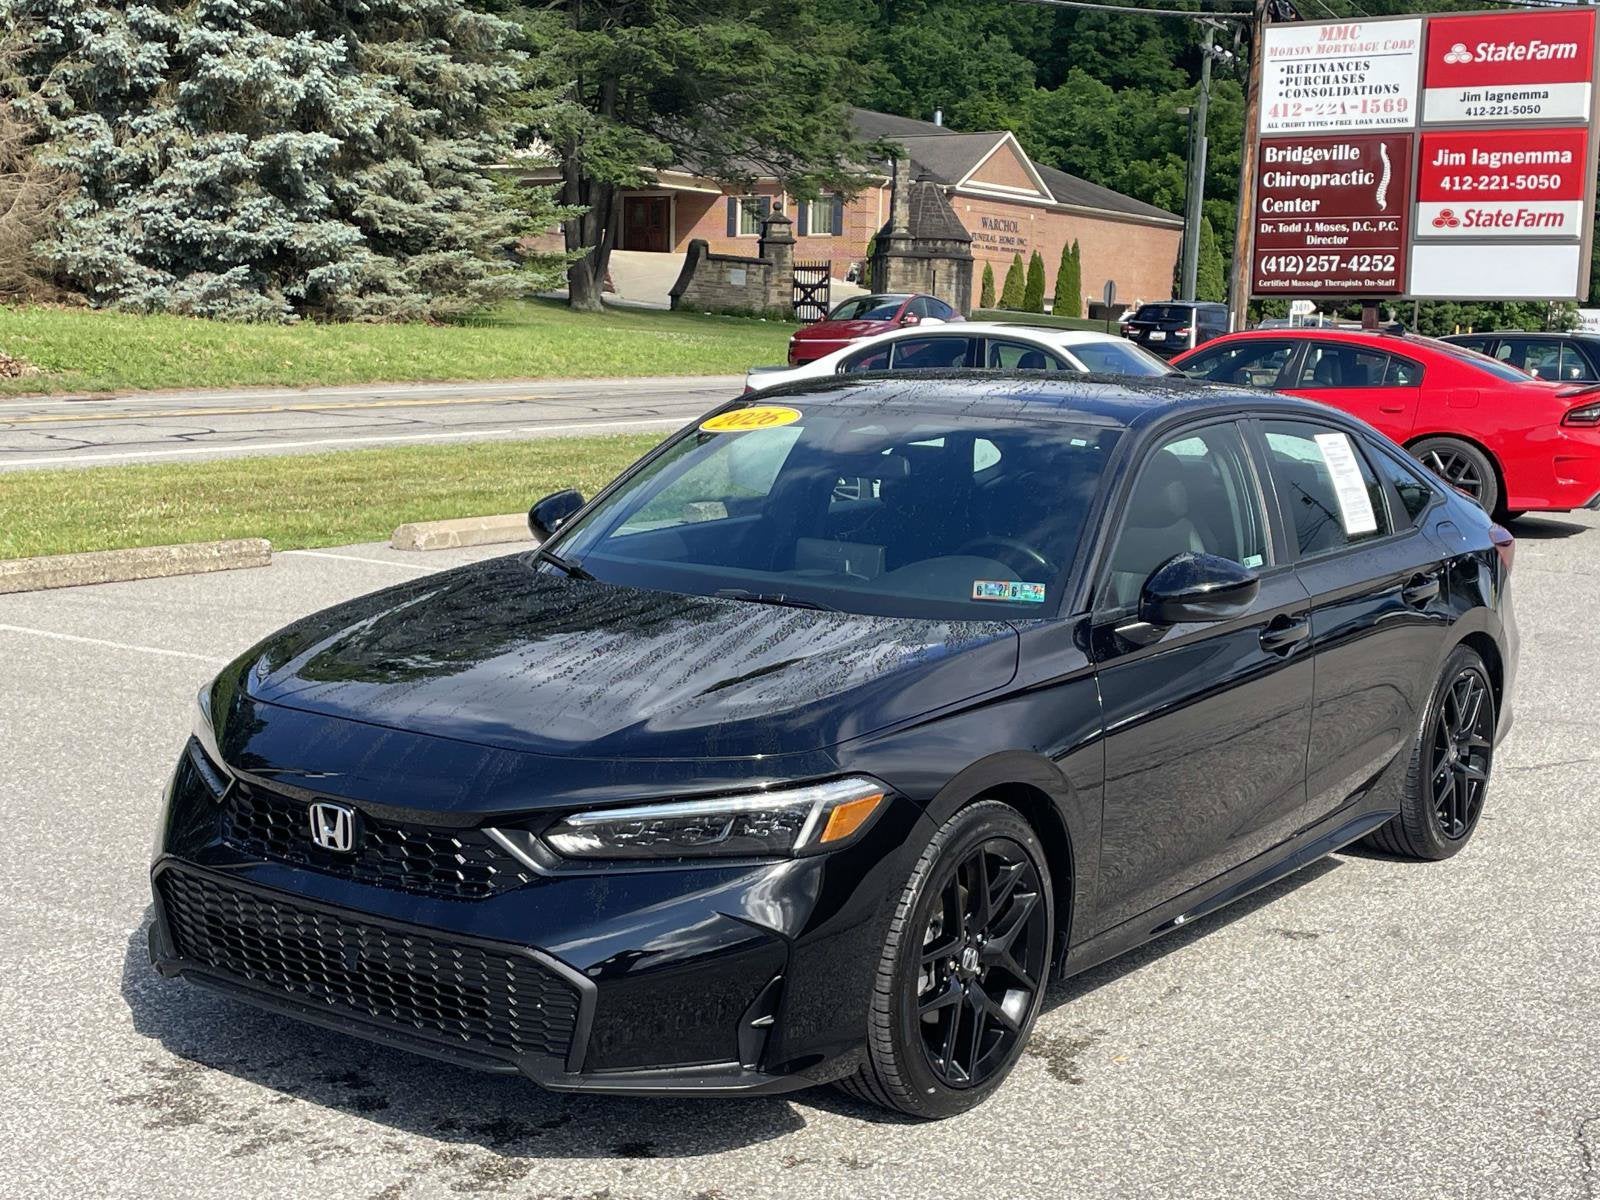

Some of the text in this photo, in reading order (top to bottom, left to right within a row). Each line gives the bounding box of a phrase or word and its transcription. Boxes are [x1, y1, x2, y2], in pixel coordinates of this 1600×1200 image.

[1319, 25, 1361, 41] MMC
[1286, 61, 1370, 75] REFINANCES
[1285, 73, 1365, 87] PURCHASES
[1285, 84, 1400, 98] CONSOLIDATIONS
[1459, 91, 1481, 103] Jim
[1268, 97, 1408, 118] 412-221-1569
[1465, 105, 1541, 116] 412-221-5050
[1267, 121, 1279, 129] ALL
[1265, 144, 1360, 165] Bridgeville
[1433, 149, 1466, 166] Jim
[1263, 169, 1375, 189] Chiropractic
[1440, 174, 1562, 191] 412-221-5050
[1261, 197, 1321, 213] Center
[981, 217, 1019, 233] WARCHOL
[1261, 223, 1276, 233] Dr.
[1278, 222, 1302, 233] Todd
[1304, 222, 1312, 232] J.
[1314, 221, 1350, 233] Moses,
[1306, 235, 1349, 245] Director
[1291, 280, 1323, 288] Massage
[1324, 279, 1363, 288] Therapists
[1364, 279, 1396, 287] On-Staff
